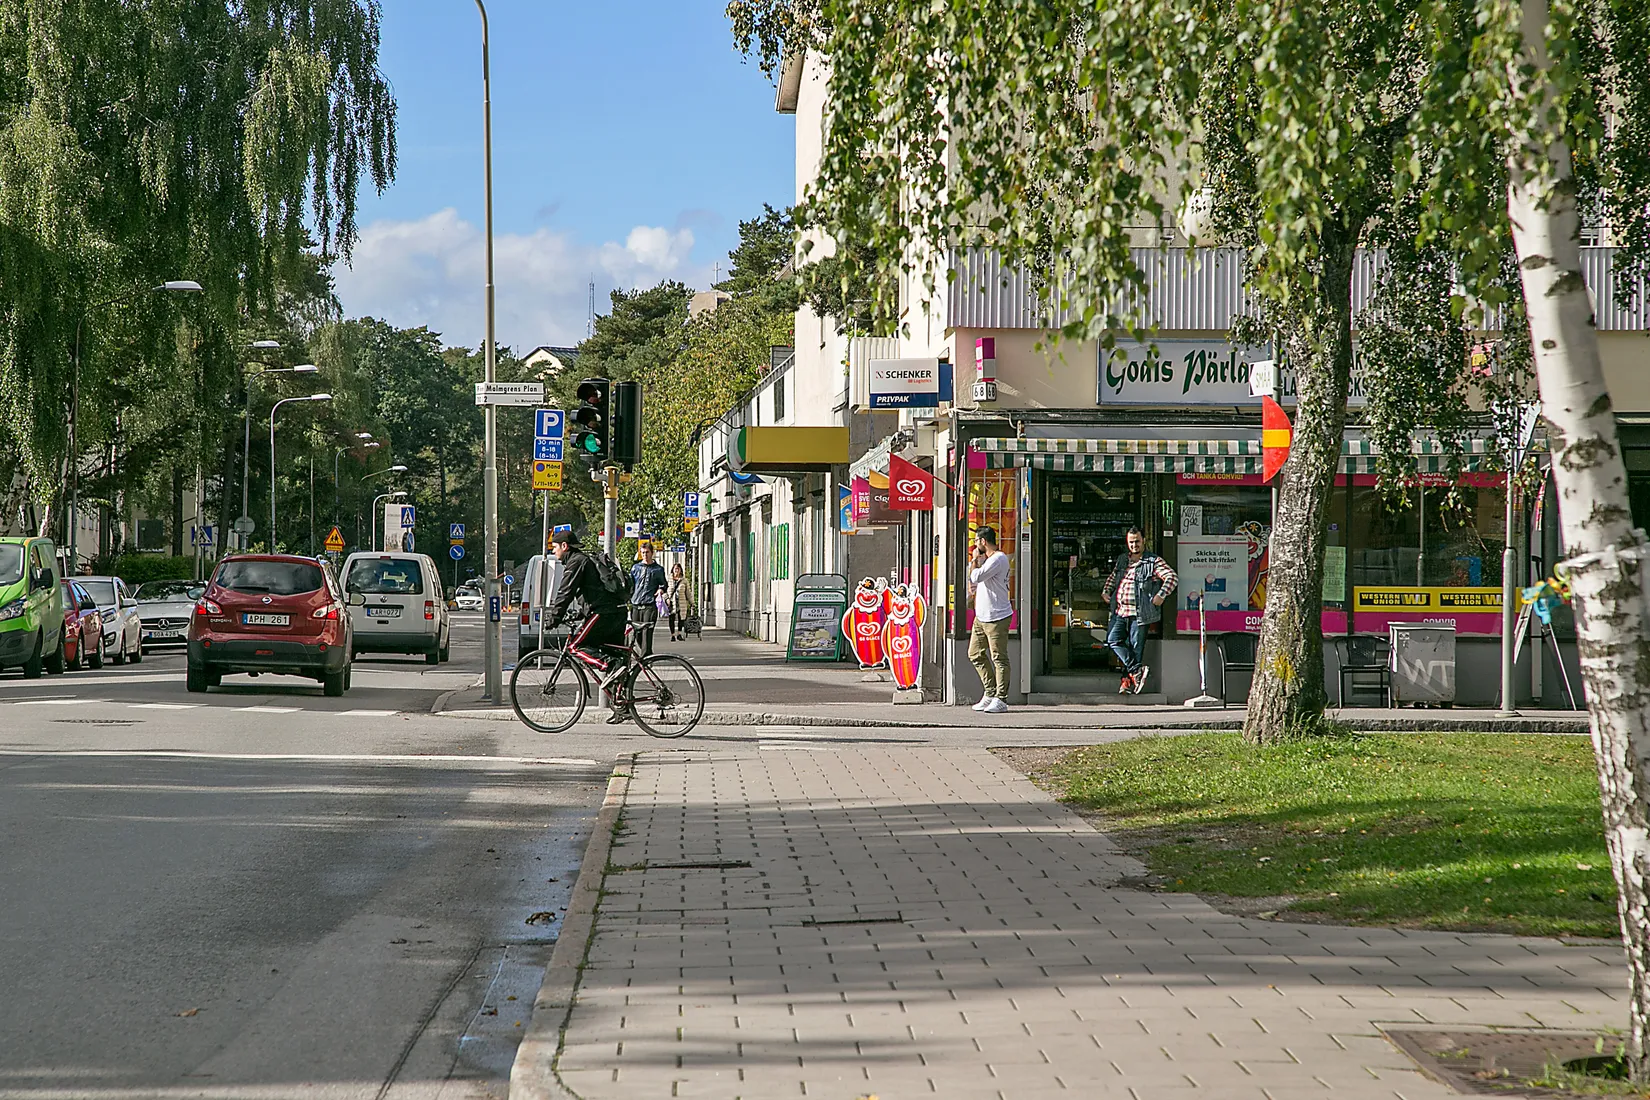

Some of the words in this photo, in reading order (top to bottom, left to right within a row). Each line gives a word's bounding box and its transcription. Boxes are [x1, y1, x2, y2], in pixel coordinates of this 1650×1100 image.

[885, 370, 932, 380] SCHENKER
[1106, 349, 1174, 395] Godis
[486, 385, 521, 394] Malmgrens
[974, 386, 985, 397] 68
[876, 395, 910, 403] PRIVPAK
[543, 412, 560, 436] P
[1182, 472, 1196, 480] OCH
[1196, 472, 1216, 480] TANKA
[688, 494, 698, 506] P
[249, 615, 266, 624] APH
[270, 616, 288, 624] 261
[1245, 616, 1263, 625] COM
